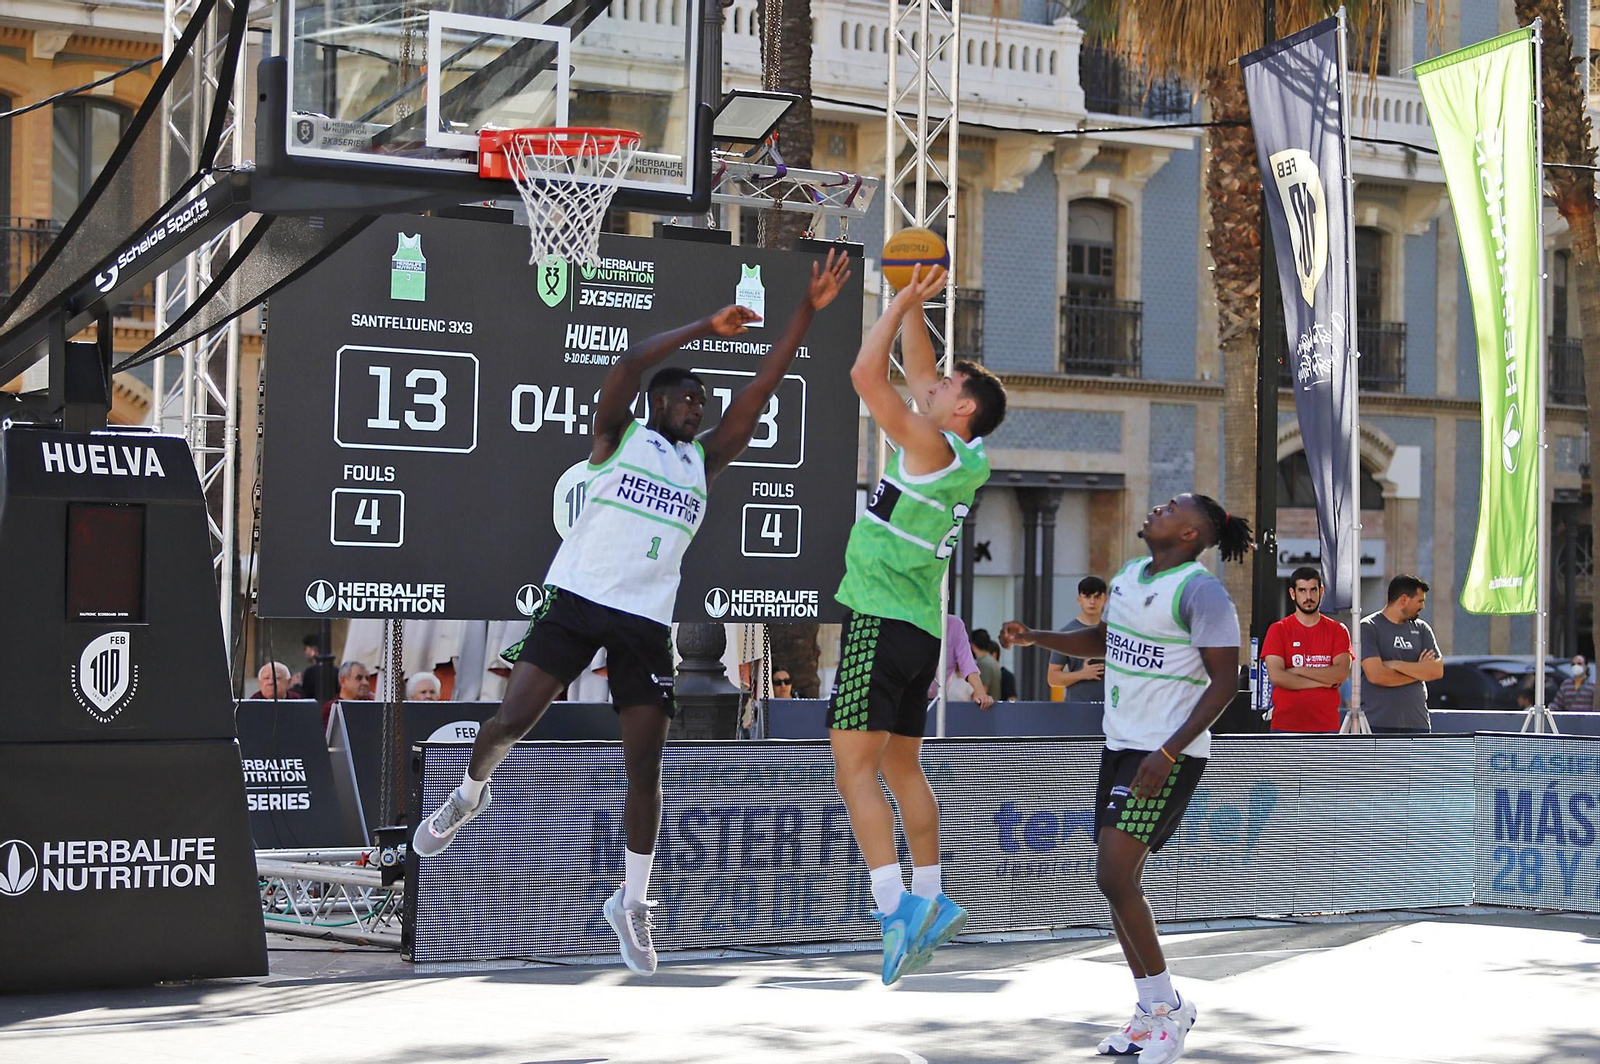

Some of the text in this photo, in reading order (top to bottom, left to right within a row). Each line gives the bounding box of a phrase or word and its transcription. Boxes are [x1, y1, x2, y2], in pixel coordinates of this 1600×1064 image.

[322, 137, 366, 147] 3X3SERIES
[635, 158, 683, 170] HERBALIFE
[635, 166, 683, 177] NUTRITION
[118, 197, 208, 270] Schelde Sports
[597, 269, 654, 283] NUTRITION
[598, 258, 654, 273] HERBALIFE
[579, 289, 653, 310] 3X3SERIES
[351, 314, 473, 334] SANTFELIUENC 3X3
[565, 324, 628, 351] HUELVA
[564, 352, 580, 364] 9-10
[580, 353, 590, 365] DE
[589, 354, 609, 366] JUNIO
[367, 366, 447, 431] 13
[41, 441, 166, 477] HUELVA
[343, 464, 396, 482] FOULS
[620, 473, 700, 513] HERBALIFE
[752, 482, 795, 498] FOULS
[354, 499, 381, 535] 4
[760, 513, 783, 546] 4
[646, 536, 662, 560] 1
[338, 582, 446, 598] HERBALIFE
[731, 589, 819, 603] HERBALIFE
[337, 597, 446, 613] NUTRITION
[730, 603, 818, 617] NUTRITION
[110, 636, 126, 645] FEB
[1107, 630, 1165, 658] RBALIFE
[90, 648, 120, 698] 100
[455, 727, 477, 738] FEB
[1494, 780, 1600, 848] MÁS
[43, 837, 216, 865] HERBALIFE
[42, 863, 216, 892] NUTRITION
[1491, 845, 1542, 894] 28
[1556, 848, 1583, 897] Y
[772, 873, 825, 930] DE
